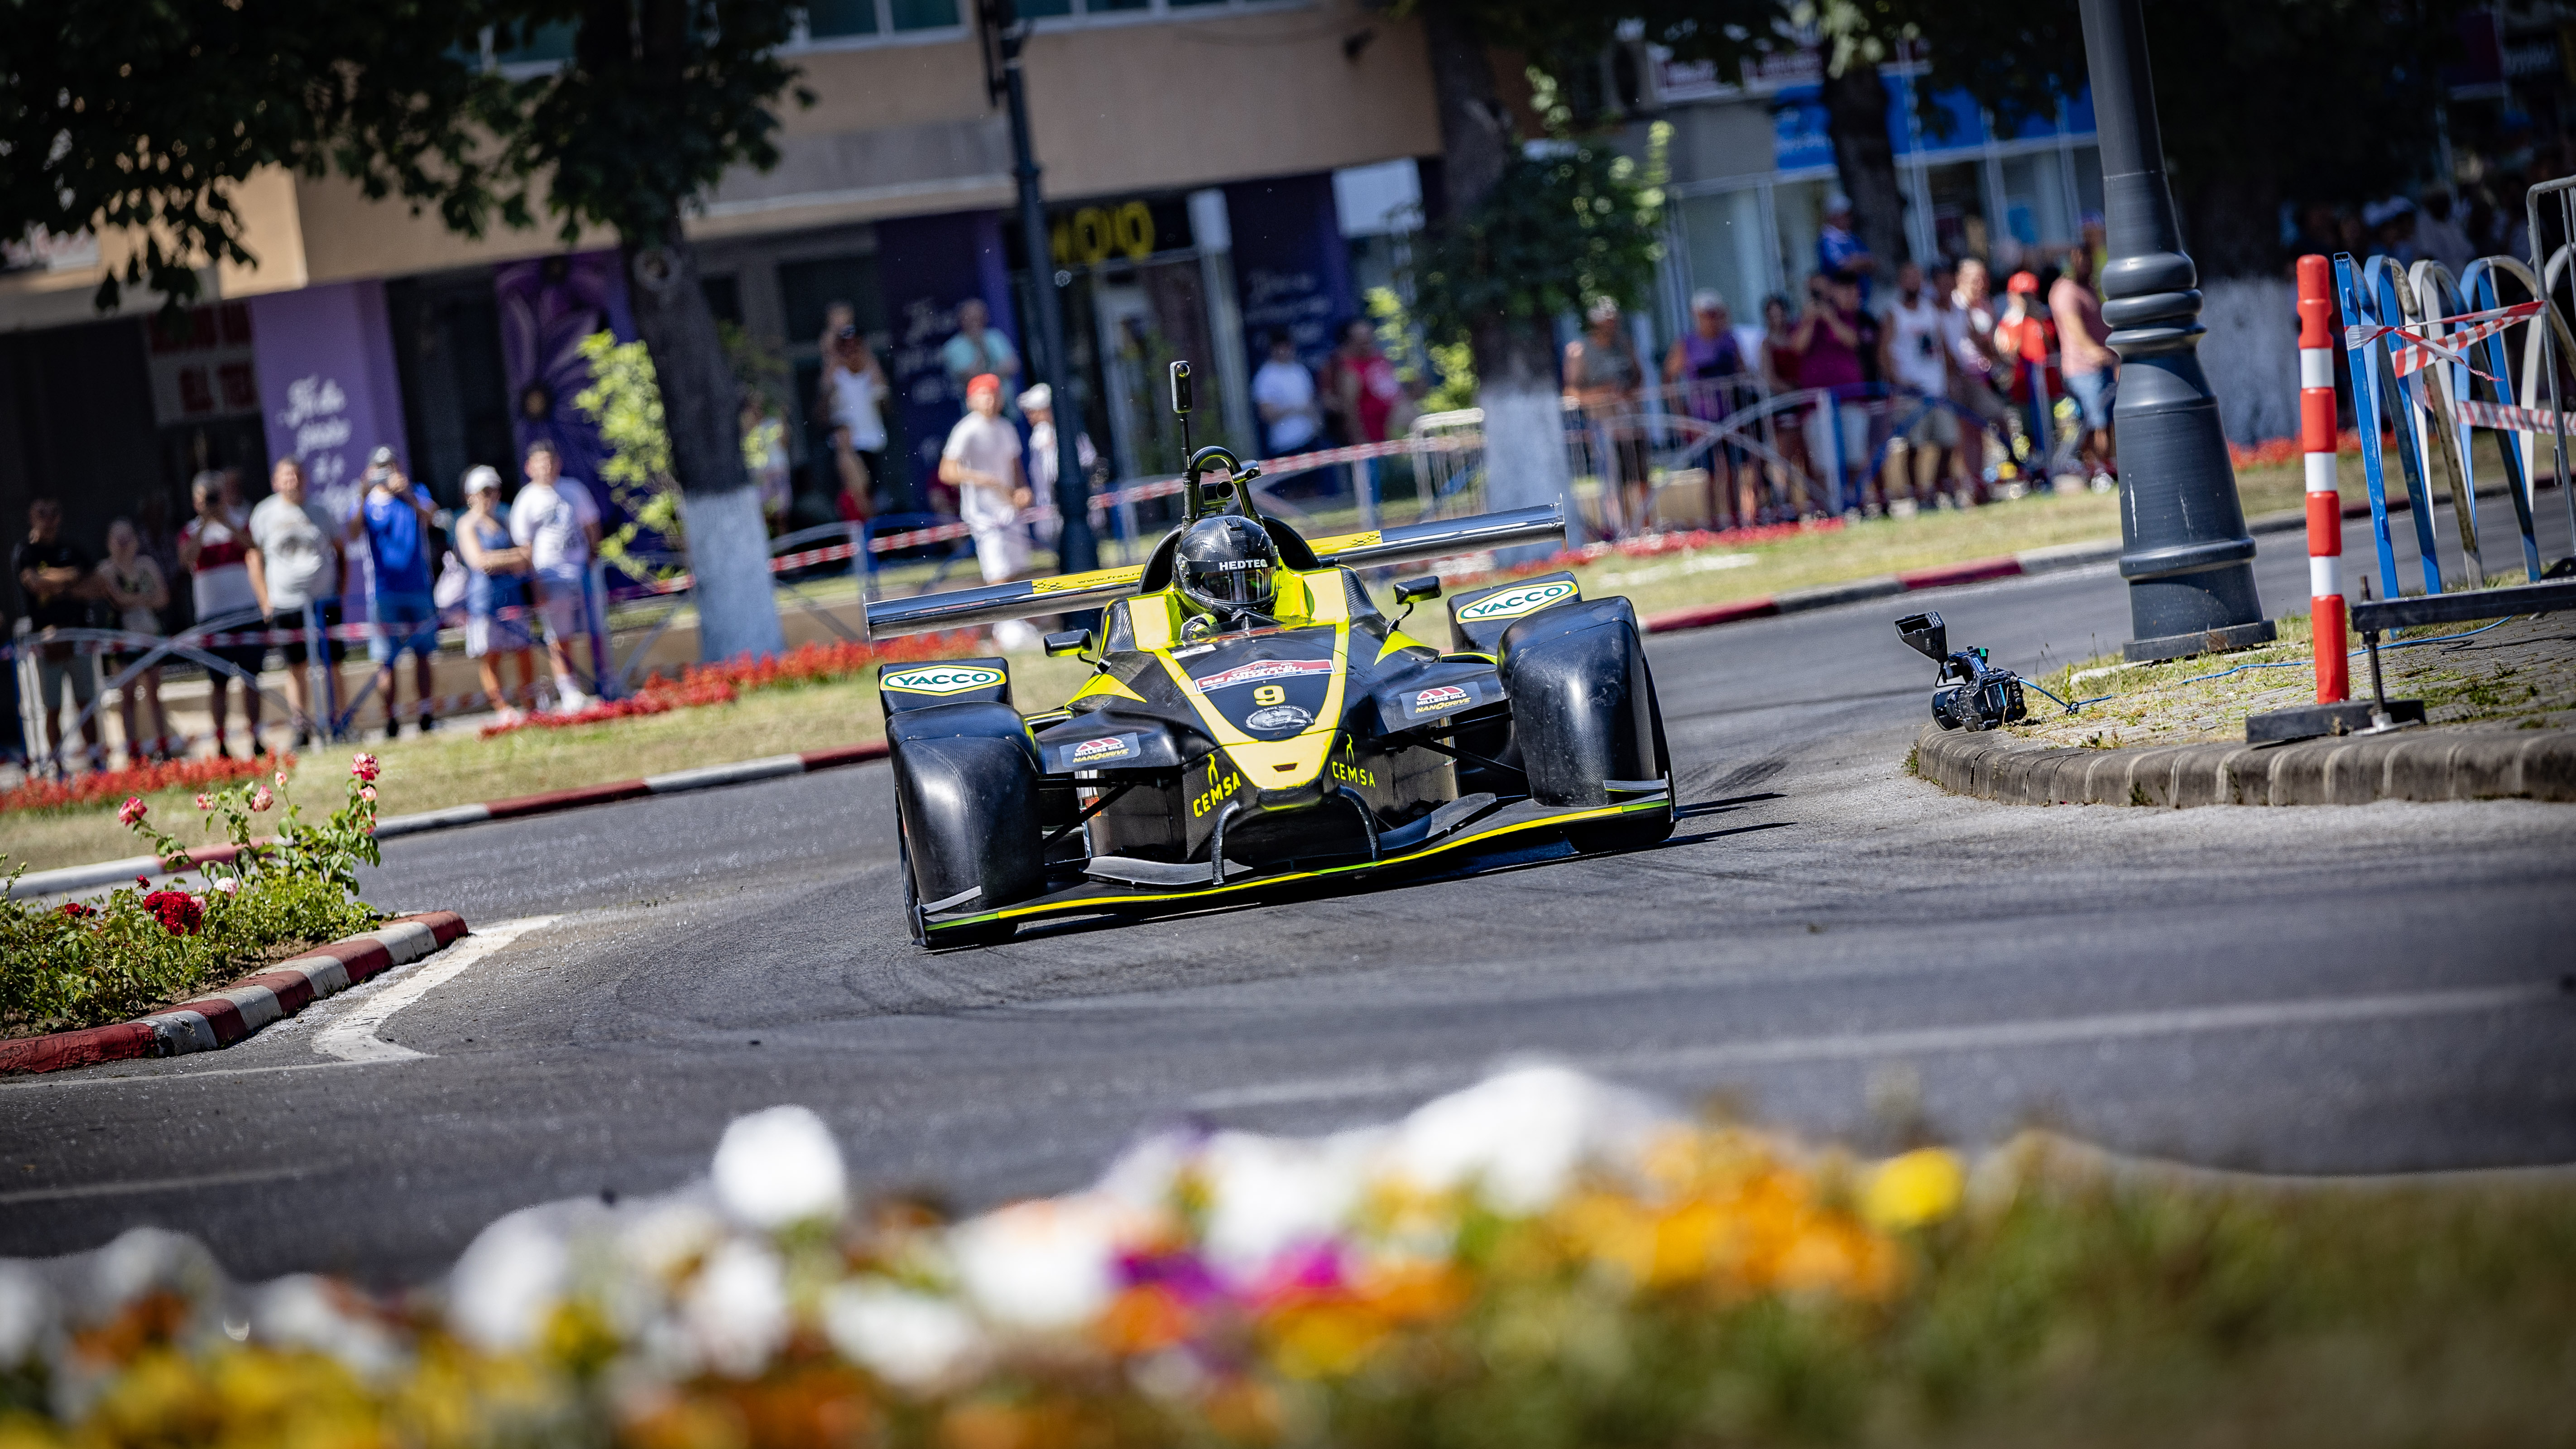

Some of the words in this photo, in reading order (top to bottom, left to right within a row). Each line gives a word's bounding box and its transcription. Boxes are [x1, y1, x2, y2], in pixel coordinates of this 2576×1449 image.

[1472, 587, 1563, 615] YACCO
[897, 673, 990, 686] YACCO
[1253, 685, 1286, 705] 9
[1416, 696, 1449, 706] MILLERS
[1415, 697, 1472, 714] NANODRIVE
[1073, 748, 1129, 763] NANODRIVE
[1075, 748, 1107, 757] MILLERS
[1332, 761, 1376, 788] CEMSA
[1193, 771, 1241, 818] CEMSA
